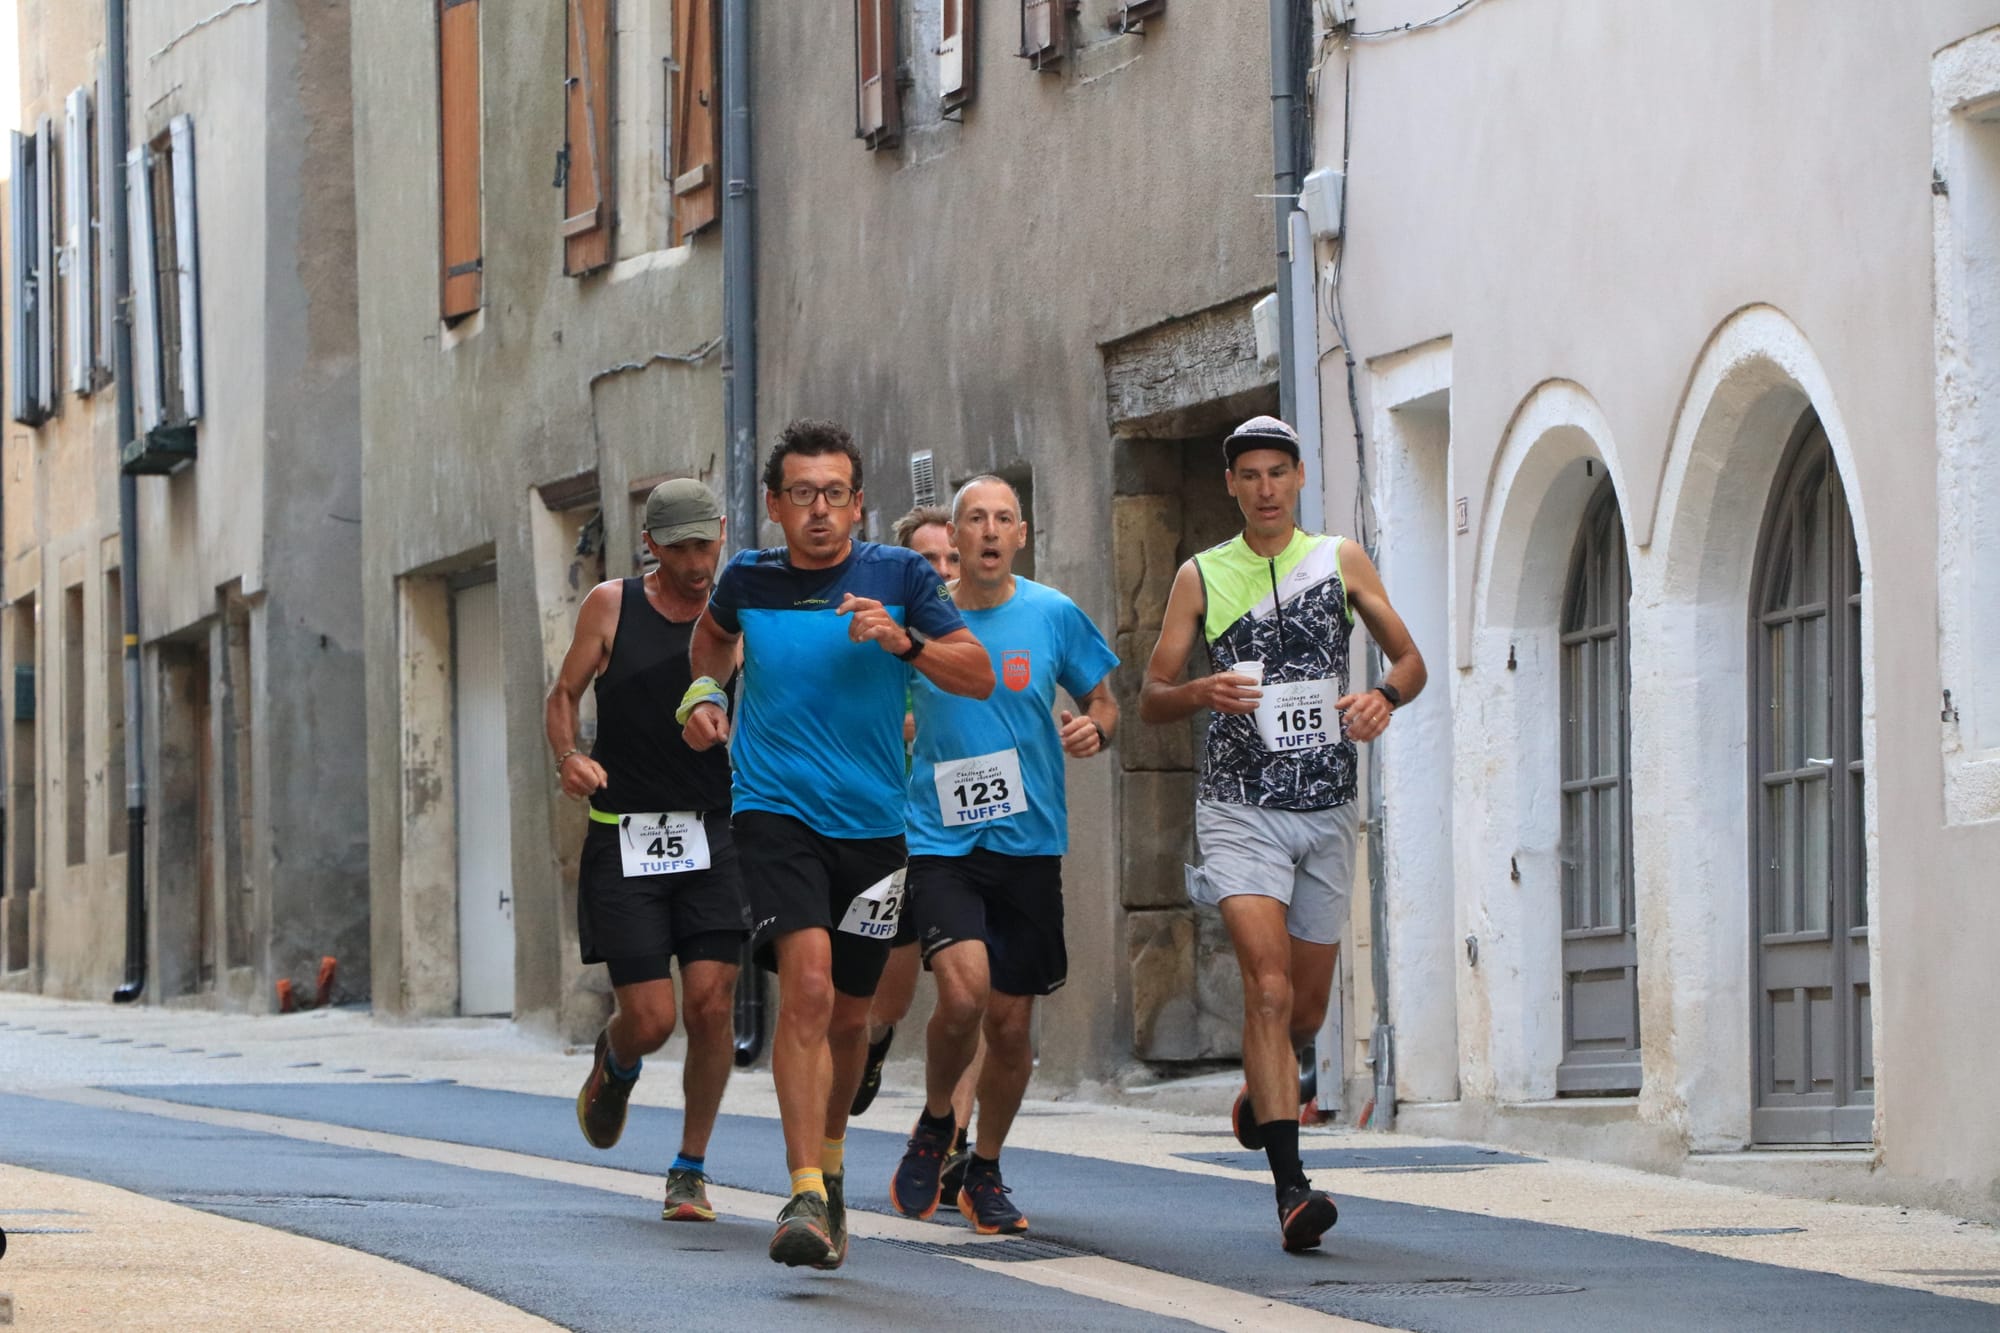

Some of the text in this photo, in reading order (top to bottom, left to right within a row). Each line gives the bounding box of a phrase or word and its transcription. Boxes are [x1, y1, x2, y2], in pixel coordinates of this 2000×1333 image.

[1277, 707, 1322, 732] 165
[1275, 731, 1327, 748] TUFF'S
[953, 778, 1009, 807] 123
[956, 802, 1012, 821] TUFF'S
[646, 836, 684, 859] 45
[640, 859, 695, 873] TUFF'S
[868, 893, 905, 921] 12
